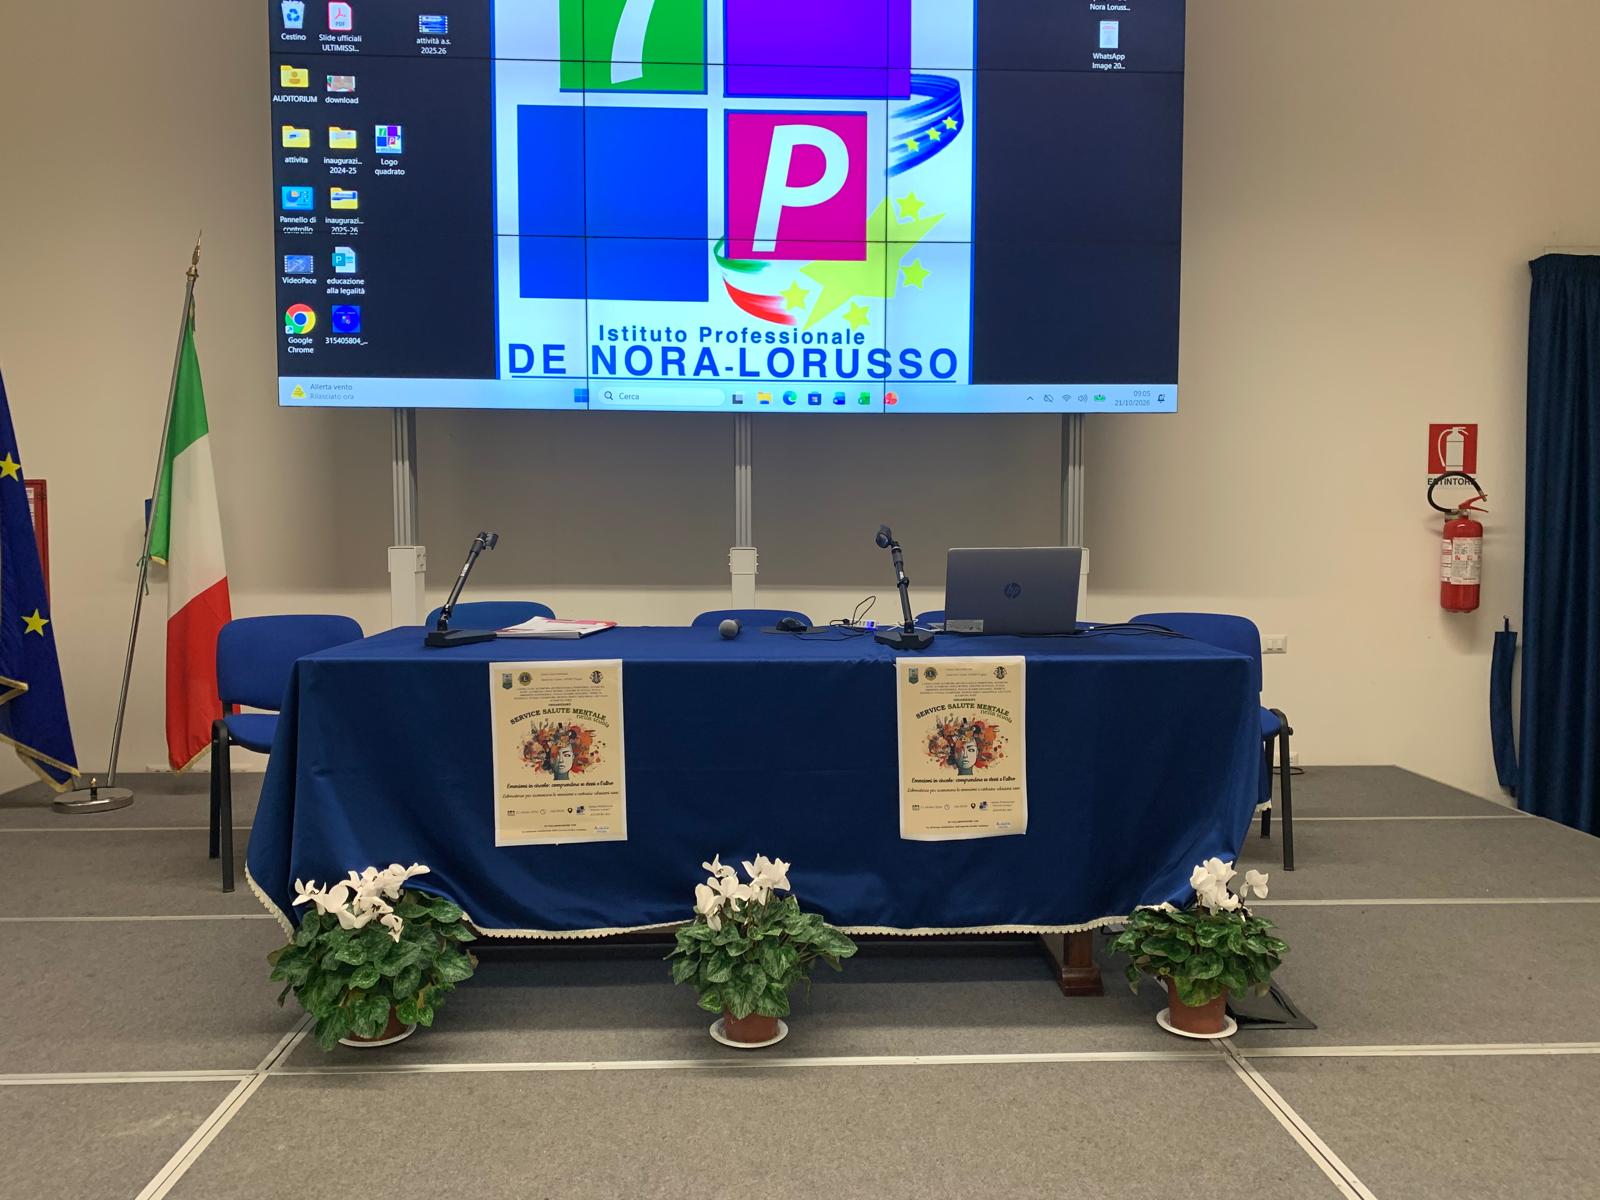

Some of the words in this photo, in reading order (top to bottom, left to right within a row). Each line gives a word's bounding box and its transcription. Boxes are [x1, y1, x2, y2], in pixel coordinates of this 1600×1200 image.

[281, 33, 306, 41] Cestino
[318, 34, 335, 42] Slide
[336, 34, 362, 43] ufficiali
[416, 37, 439, 45] attività
[420, 47, 447, 55] 2025.26
[1092, 53, 1126, 61] WhatsApp
[1092, 62, 1112, 70] Image
[273, 94, 318, 103] AUDITORIUM
[325, 96, 359, 104] download
[284, 156, 308, 164] attivita
[380, 158, 398, 167] Logo
[374, 168, 405, 176] quadrato
[751, 124, 850, 252] P
[279, 216, 308, 224] Pannello
[309, 216, 317, 224] di
[282, 277, 317, 285] VideoPace
[326, 277, 365, 285] educazione
[340, 287, 365, 296] legalità
[599, 325, 687, 343] Istituto
[699, 326, 865, 344] Professionale
[288, 337, 313, 346] Google
[288, 346, 314, 354] Chrome
[508, 343, 567, 374] DE
[591, 344, 958, 379] NORA-LORUSSO
[310, 383, 332, 391] Allerta
[618, 392, 640, 401] Cerca
[915, 704, 946, 719] SERVICE
[976, 703, 1010, 716] MENTALE
[510, 709, 541, 725] SERVICE
[572, 708, 607, 721] MENTALE
